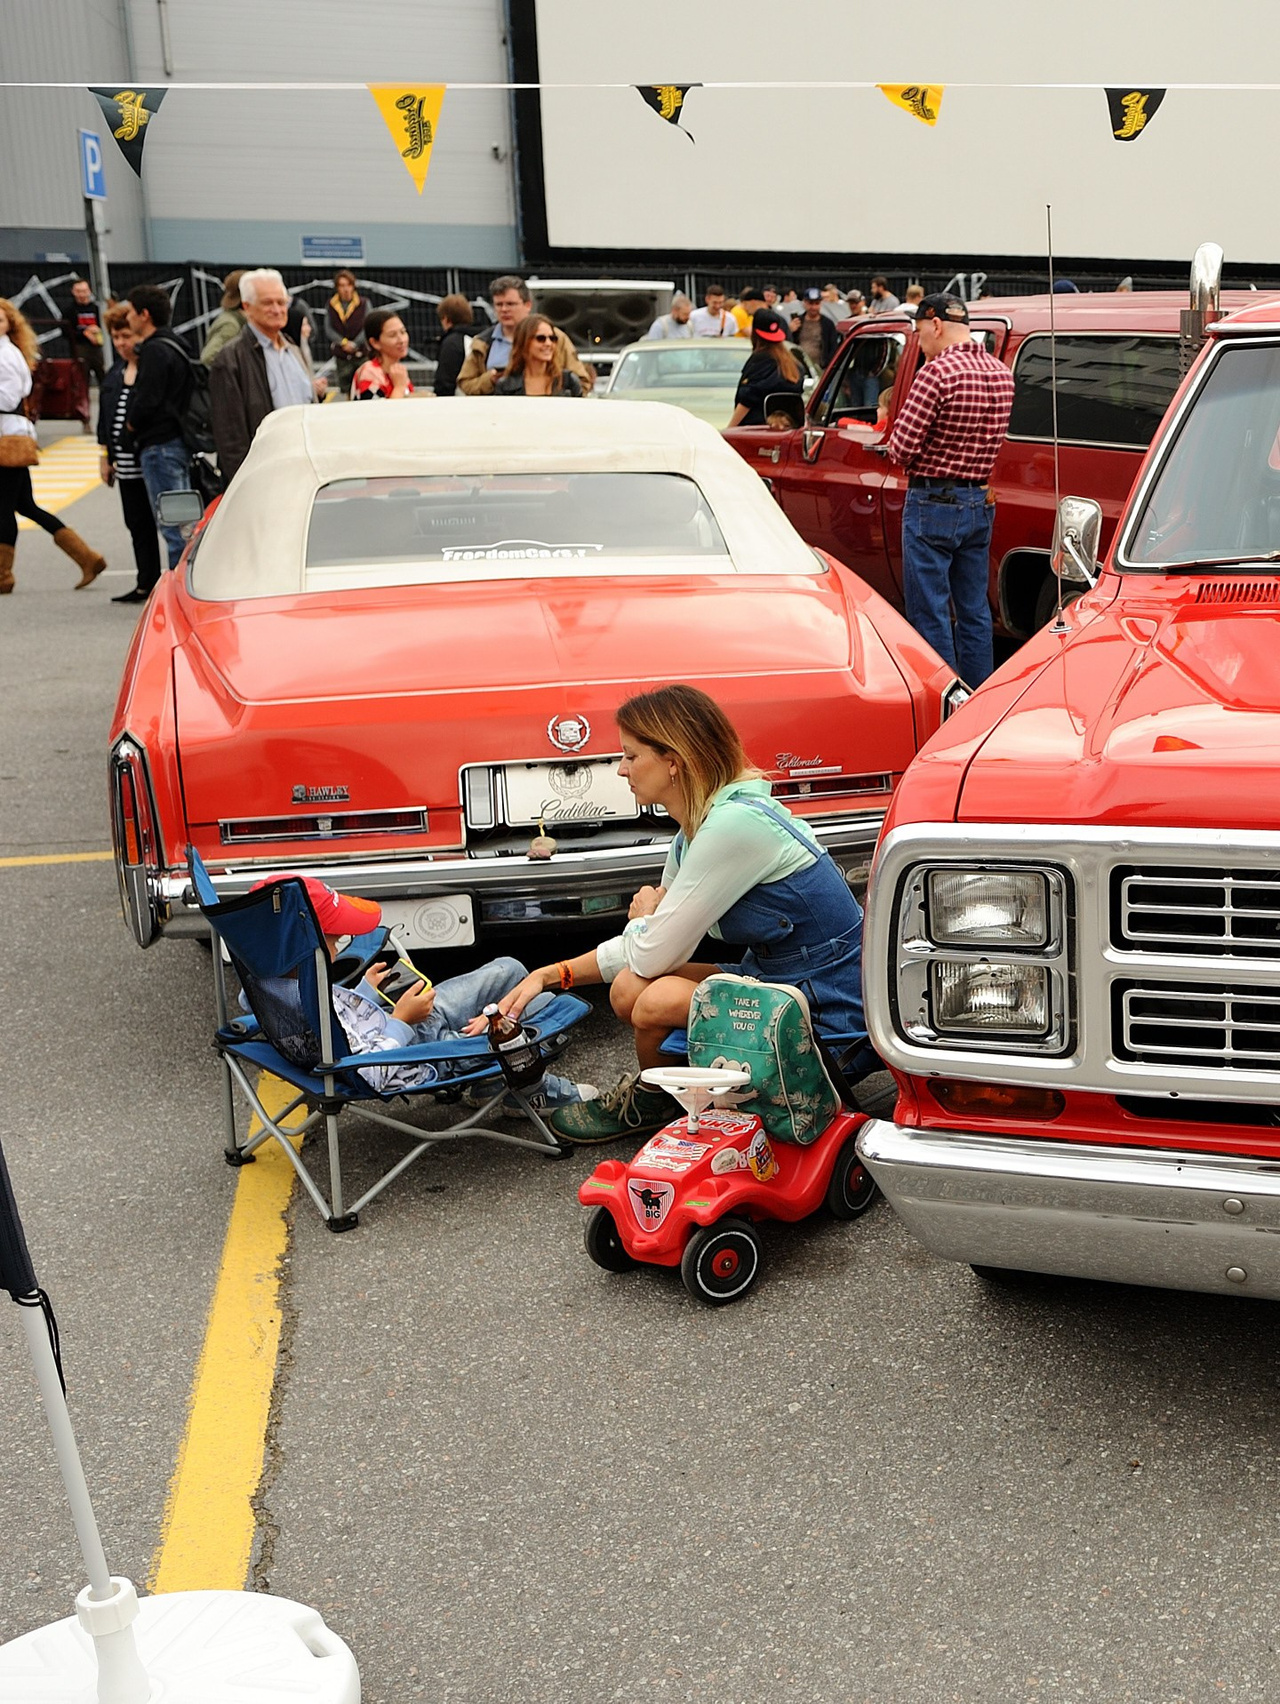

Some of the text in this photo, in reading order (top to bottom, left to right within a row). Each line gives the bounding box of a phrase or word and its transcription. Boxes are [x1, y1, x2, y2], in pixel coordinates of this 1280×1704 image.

[85, 138, 102, 190] P
[776, 752, 823, 769] Eldorado
[309, 785, 348, 796] HAWLEY
[540, 799, 607, 820] Cadillac
[734, 997, 760, 1007] TAKE ME
[729, 1009, 761, 1020] WHEREVER
[733, 1021, 756, 1031] YOU GO
[645, 1210, 660, 1218] BIG
